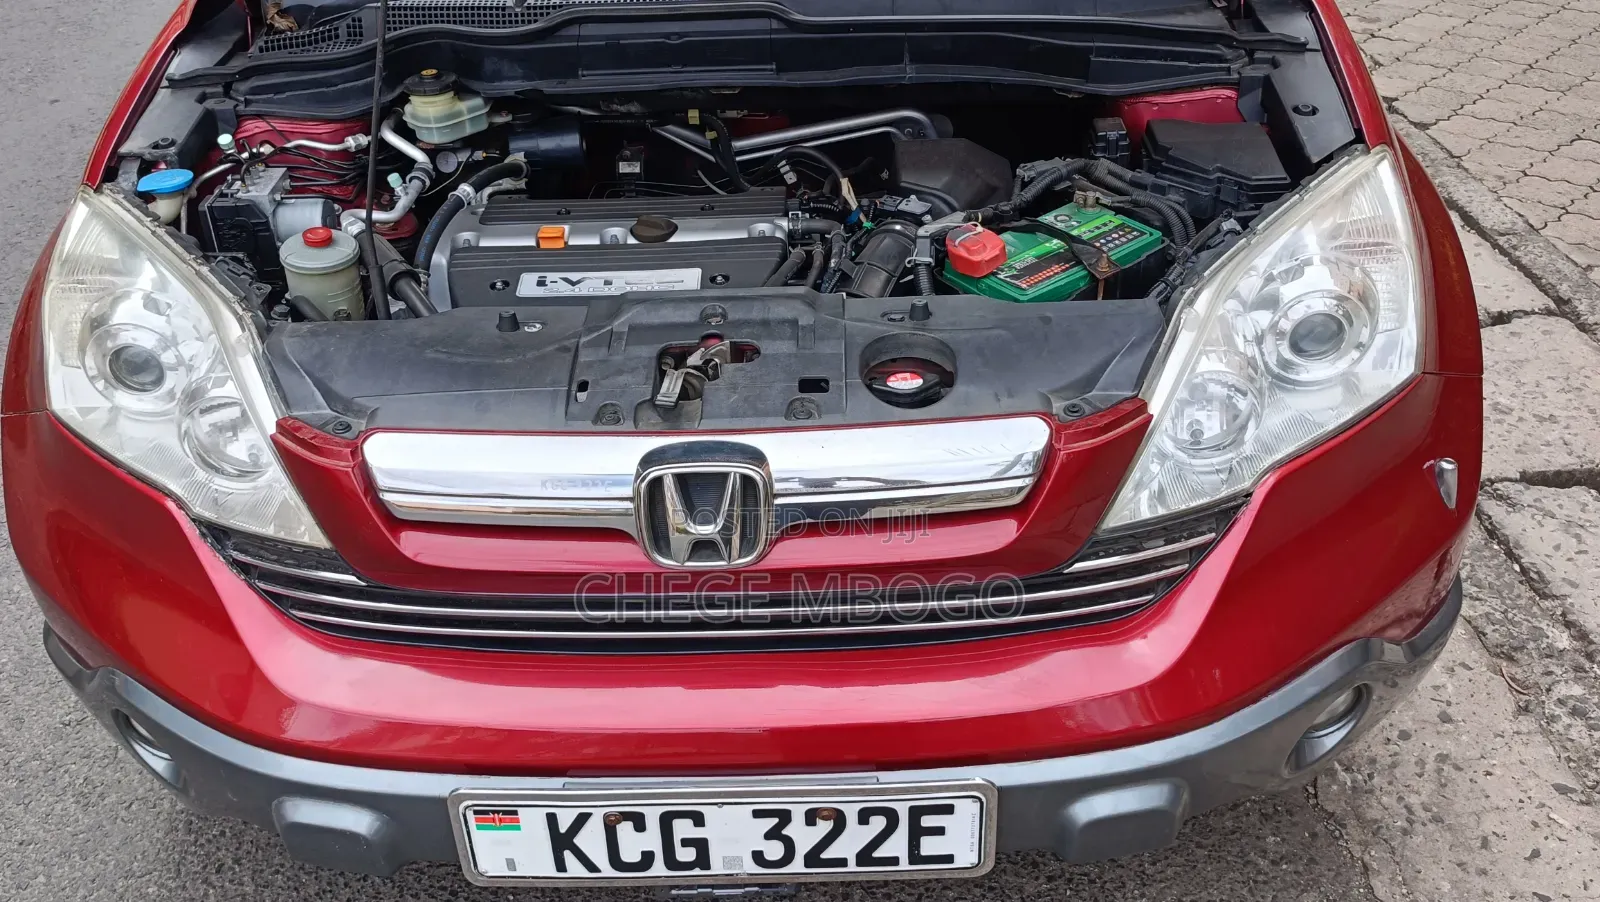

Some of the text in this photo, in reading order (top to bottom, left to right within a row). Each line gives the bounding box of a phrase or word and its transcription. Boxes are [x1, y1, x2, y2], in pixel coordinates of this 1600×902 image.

[536, 274, 684, 288] i-VT
[545, 809, 711, 873] KCG
[750, 803, 956, 869] 322E
